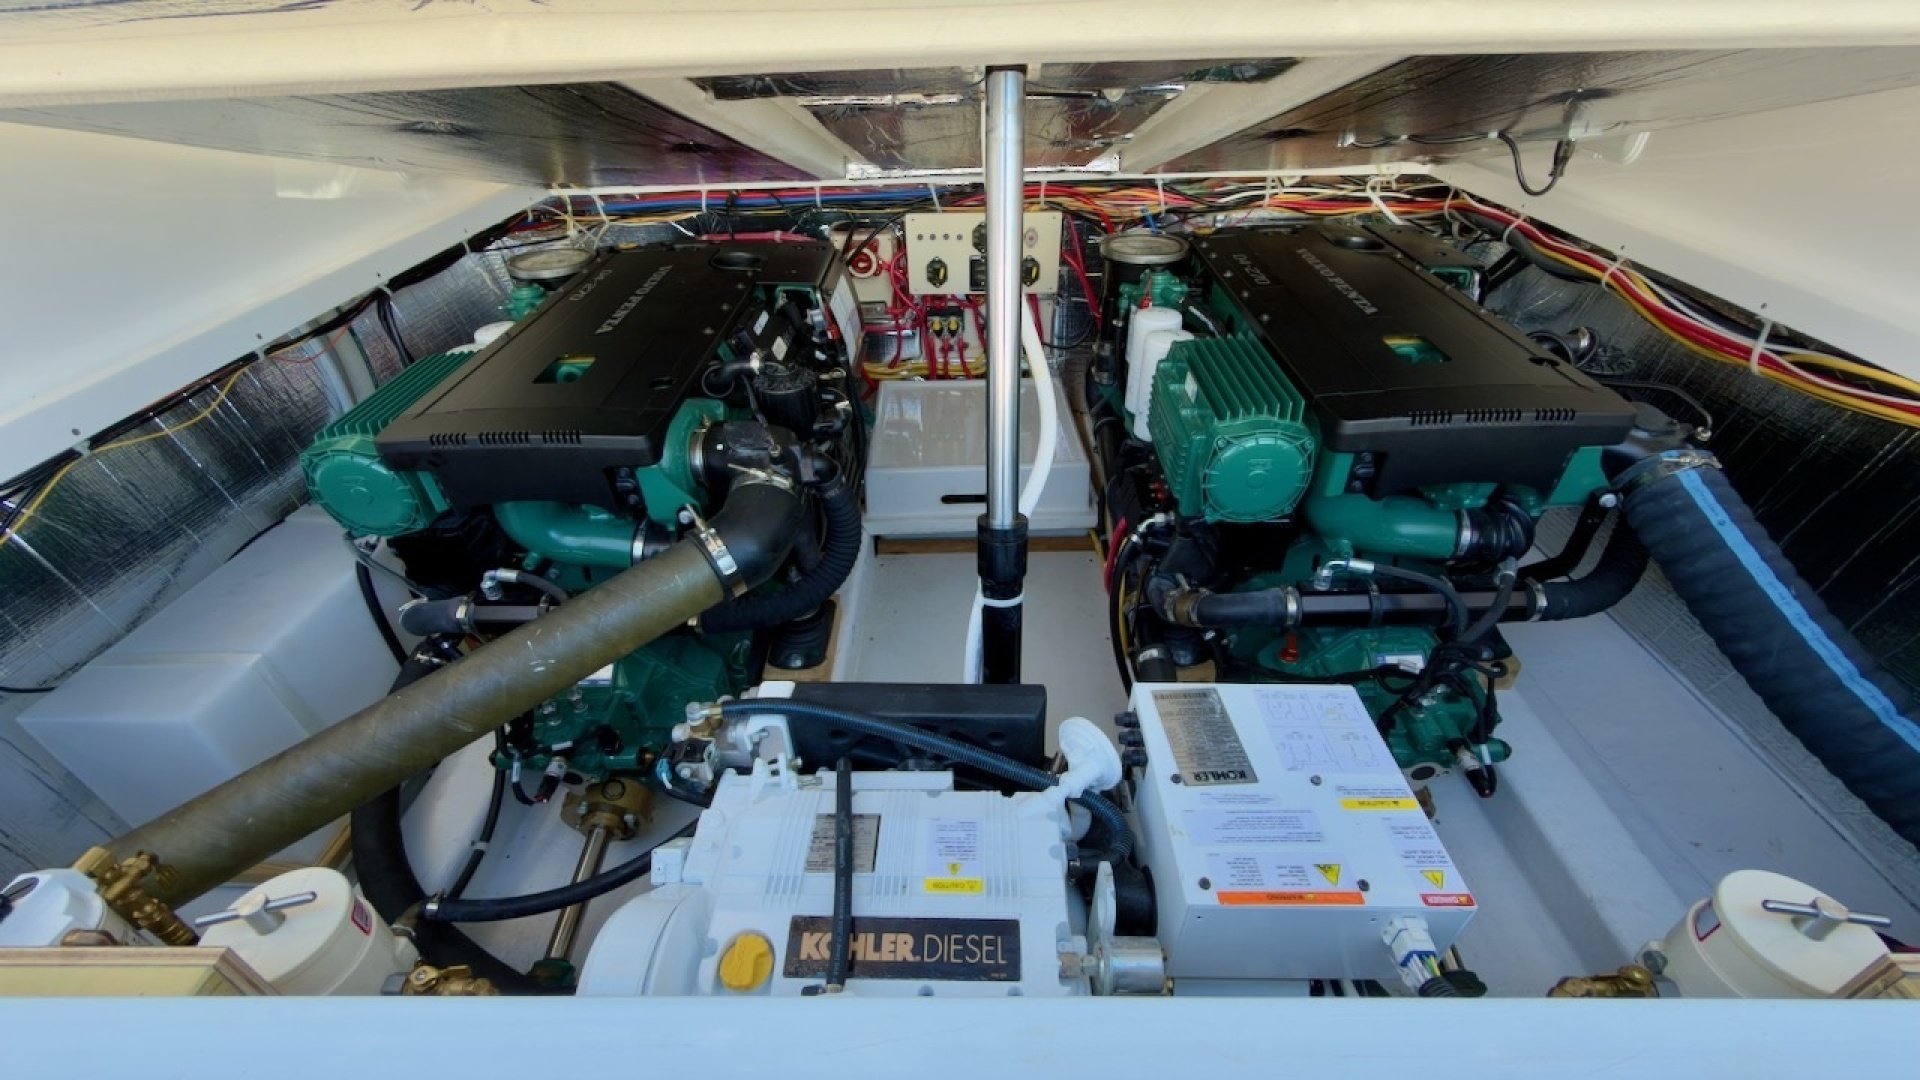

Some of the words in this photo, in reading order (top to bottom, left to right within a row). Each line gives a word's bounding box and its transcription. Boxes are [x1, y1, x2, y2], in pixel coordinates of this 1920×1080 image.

[1328, 277, 1378, 315] PENTA
[1194, 770, 1248, 781] KOHLER
[923, 934, 1007, 964] DIESEL
